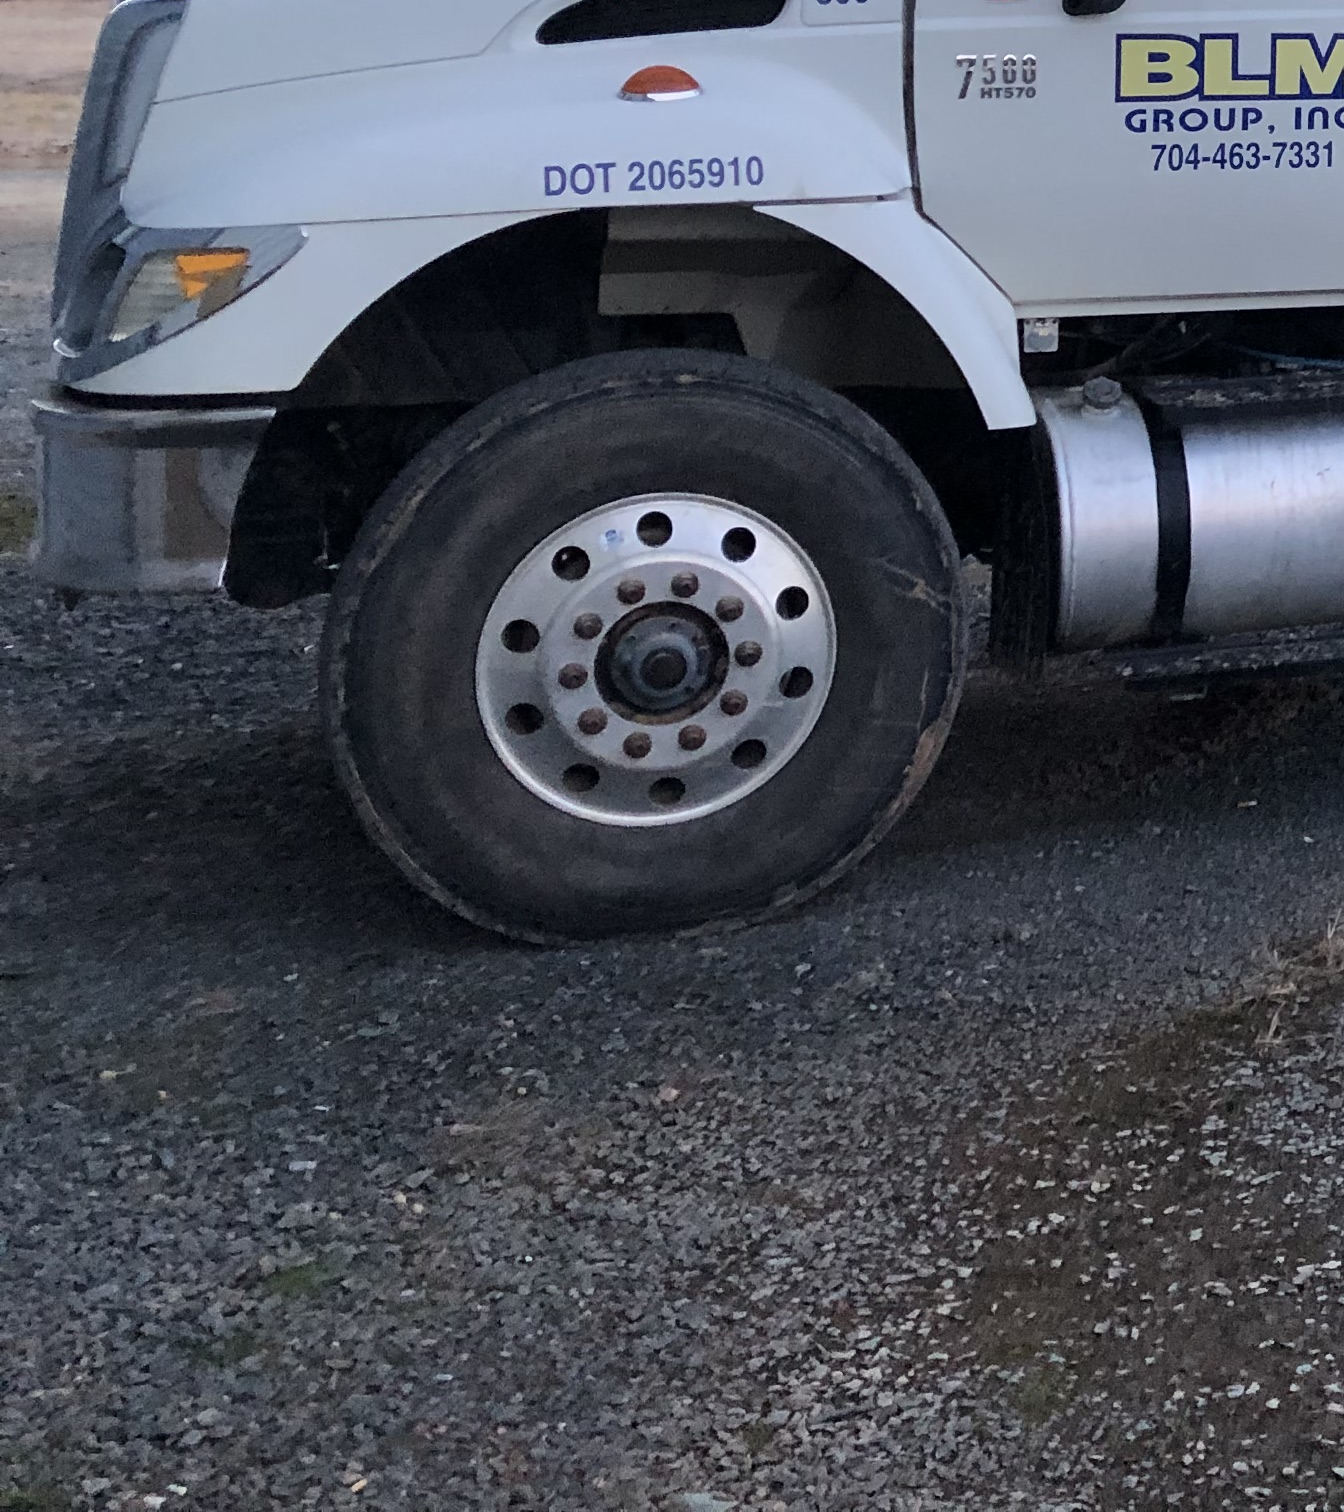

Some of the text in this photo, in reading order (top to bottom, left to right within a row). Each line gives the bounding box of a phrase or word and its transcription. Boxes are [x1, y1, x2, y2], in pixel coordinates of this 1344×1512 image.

[956, 54, 1037, 100] 7500
[980, 87, 1037, 99] HT570
[1124, 108, 1275, 134] GROUP,
[1150, 141, 1334, 171] 704-463-7331
[544, 156, 764, 196] DOT 2065910
